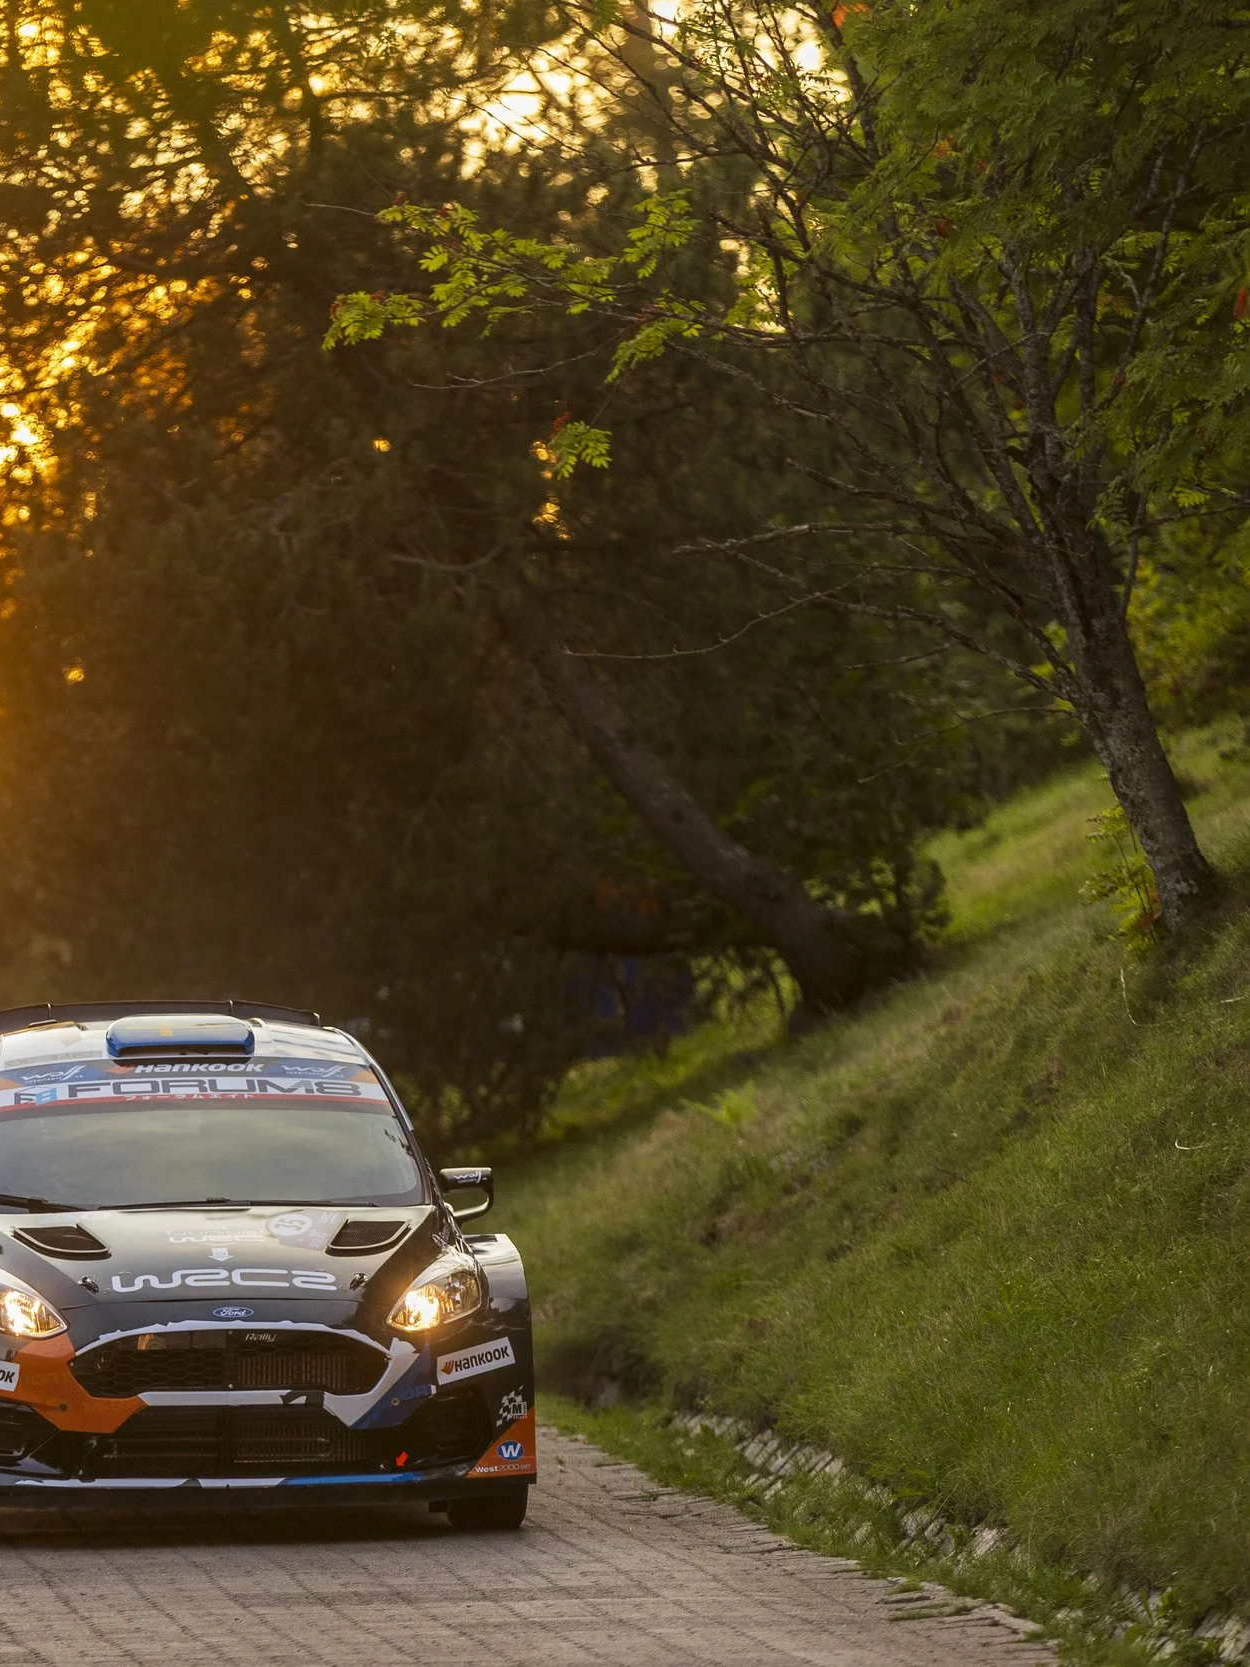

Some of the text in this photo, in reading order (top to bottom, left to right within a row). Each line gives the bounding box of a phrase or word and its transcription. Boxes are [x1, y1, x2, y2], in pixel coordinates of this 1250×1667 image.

[68, 1078, 362, 1097] FORUM8
[111, 1267, 337, 1293] WRC2
[245, 1332, 277, 1343] Rally
[500, 1442, 522, 1458] W
